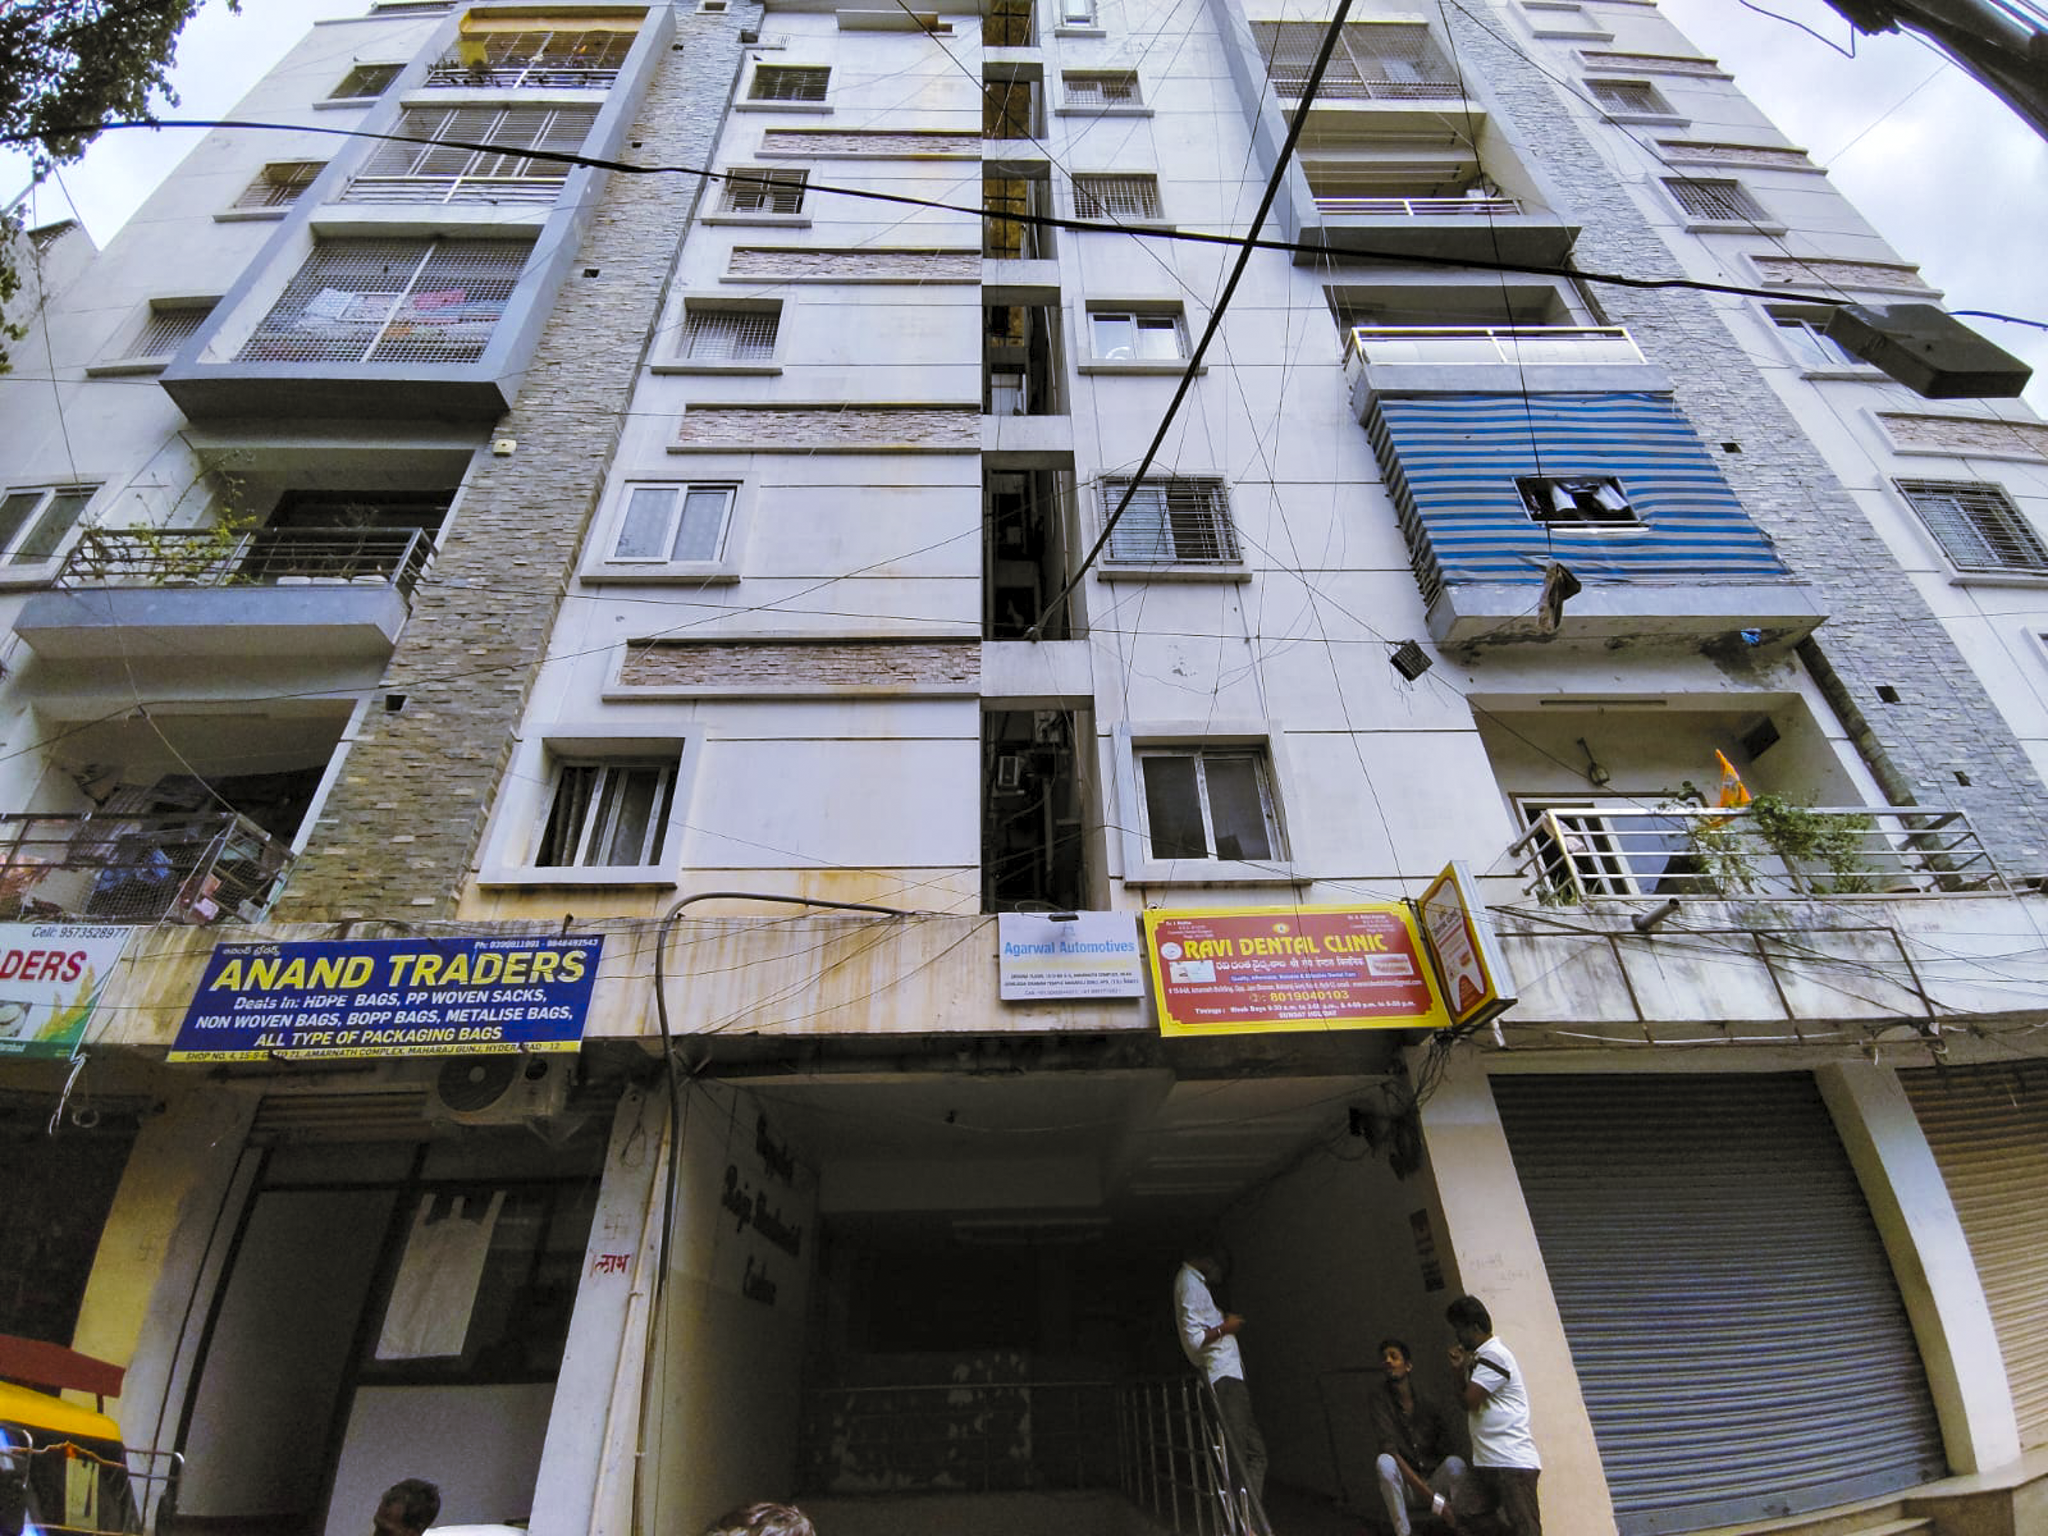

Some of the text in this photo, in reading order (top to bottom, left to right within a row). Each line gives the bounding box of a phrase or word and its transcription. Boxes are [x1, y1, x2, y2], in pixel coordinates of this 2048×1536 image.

[32, 926, 57, 939] Cell:
[1004, 939, 1135, 957] Agarwal Automotives
[1183, 933, 1388, 960] RAVI DENTAL CLINIC
[0, 949, 87, 982] DERS
[208, 950, 588, 992] ANAND TRADERS
[233, 996, 277, 1010] Deals
[302, 995, 348, 1009] HDPE
[354, 992, 401, 1008] BAGS,
[405, 991, 428, 1005] PP
[431, 989, 487, 1005] WOVEN
[491, 987, 547, 1004] SACKS,
[195, 1004, 574, 1030] NON WOVEN BAGS, BOPP BAGS, METALISE BAGS,
[253, 1025, 503, 1048] ALL TYPE OF PACKAGING BAGS
[186, 1051, 211, 1060] SHOP
[305, 1047, 357, 1057] AMARNATH
[408, 1044, 455, 1054] MAHARAJ
